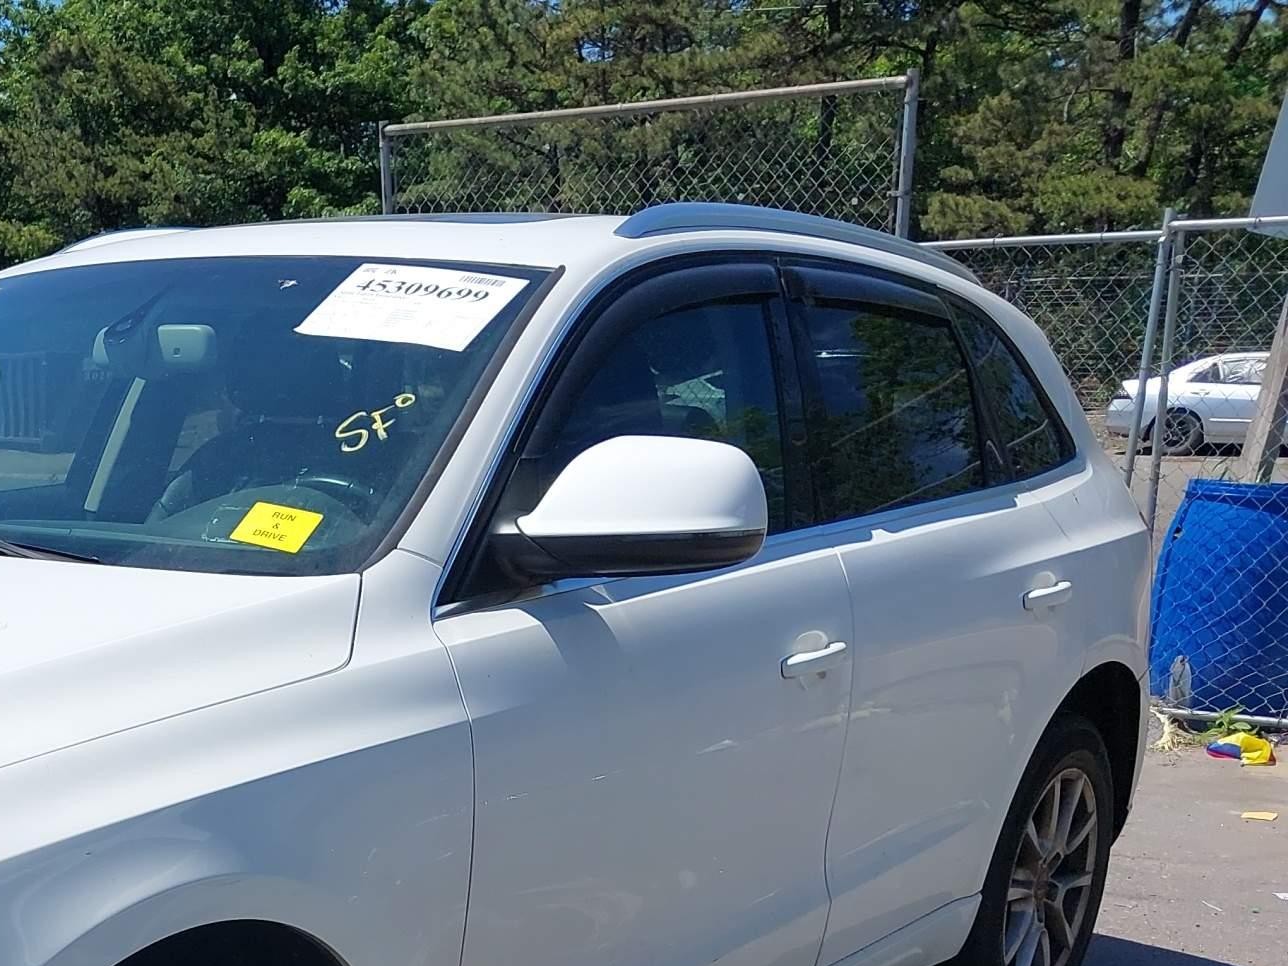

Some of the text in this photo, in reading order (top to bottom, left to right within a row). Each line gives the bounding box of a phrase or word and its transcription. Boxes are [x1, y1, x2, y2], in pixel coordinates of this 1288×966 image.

[356, 279, 490, 303] 45309699
[272, 511, 297, 522] RUN
[272, 522, 281, 530] &
[252, 528, 288, 542] DRIVE
